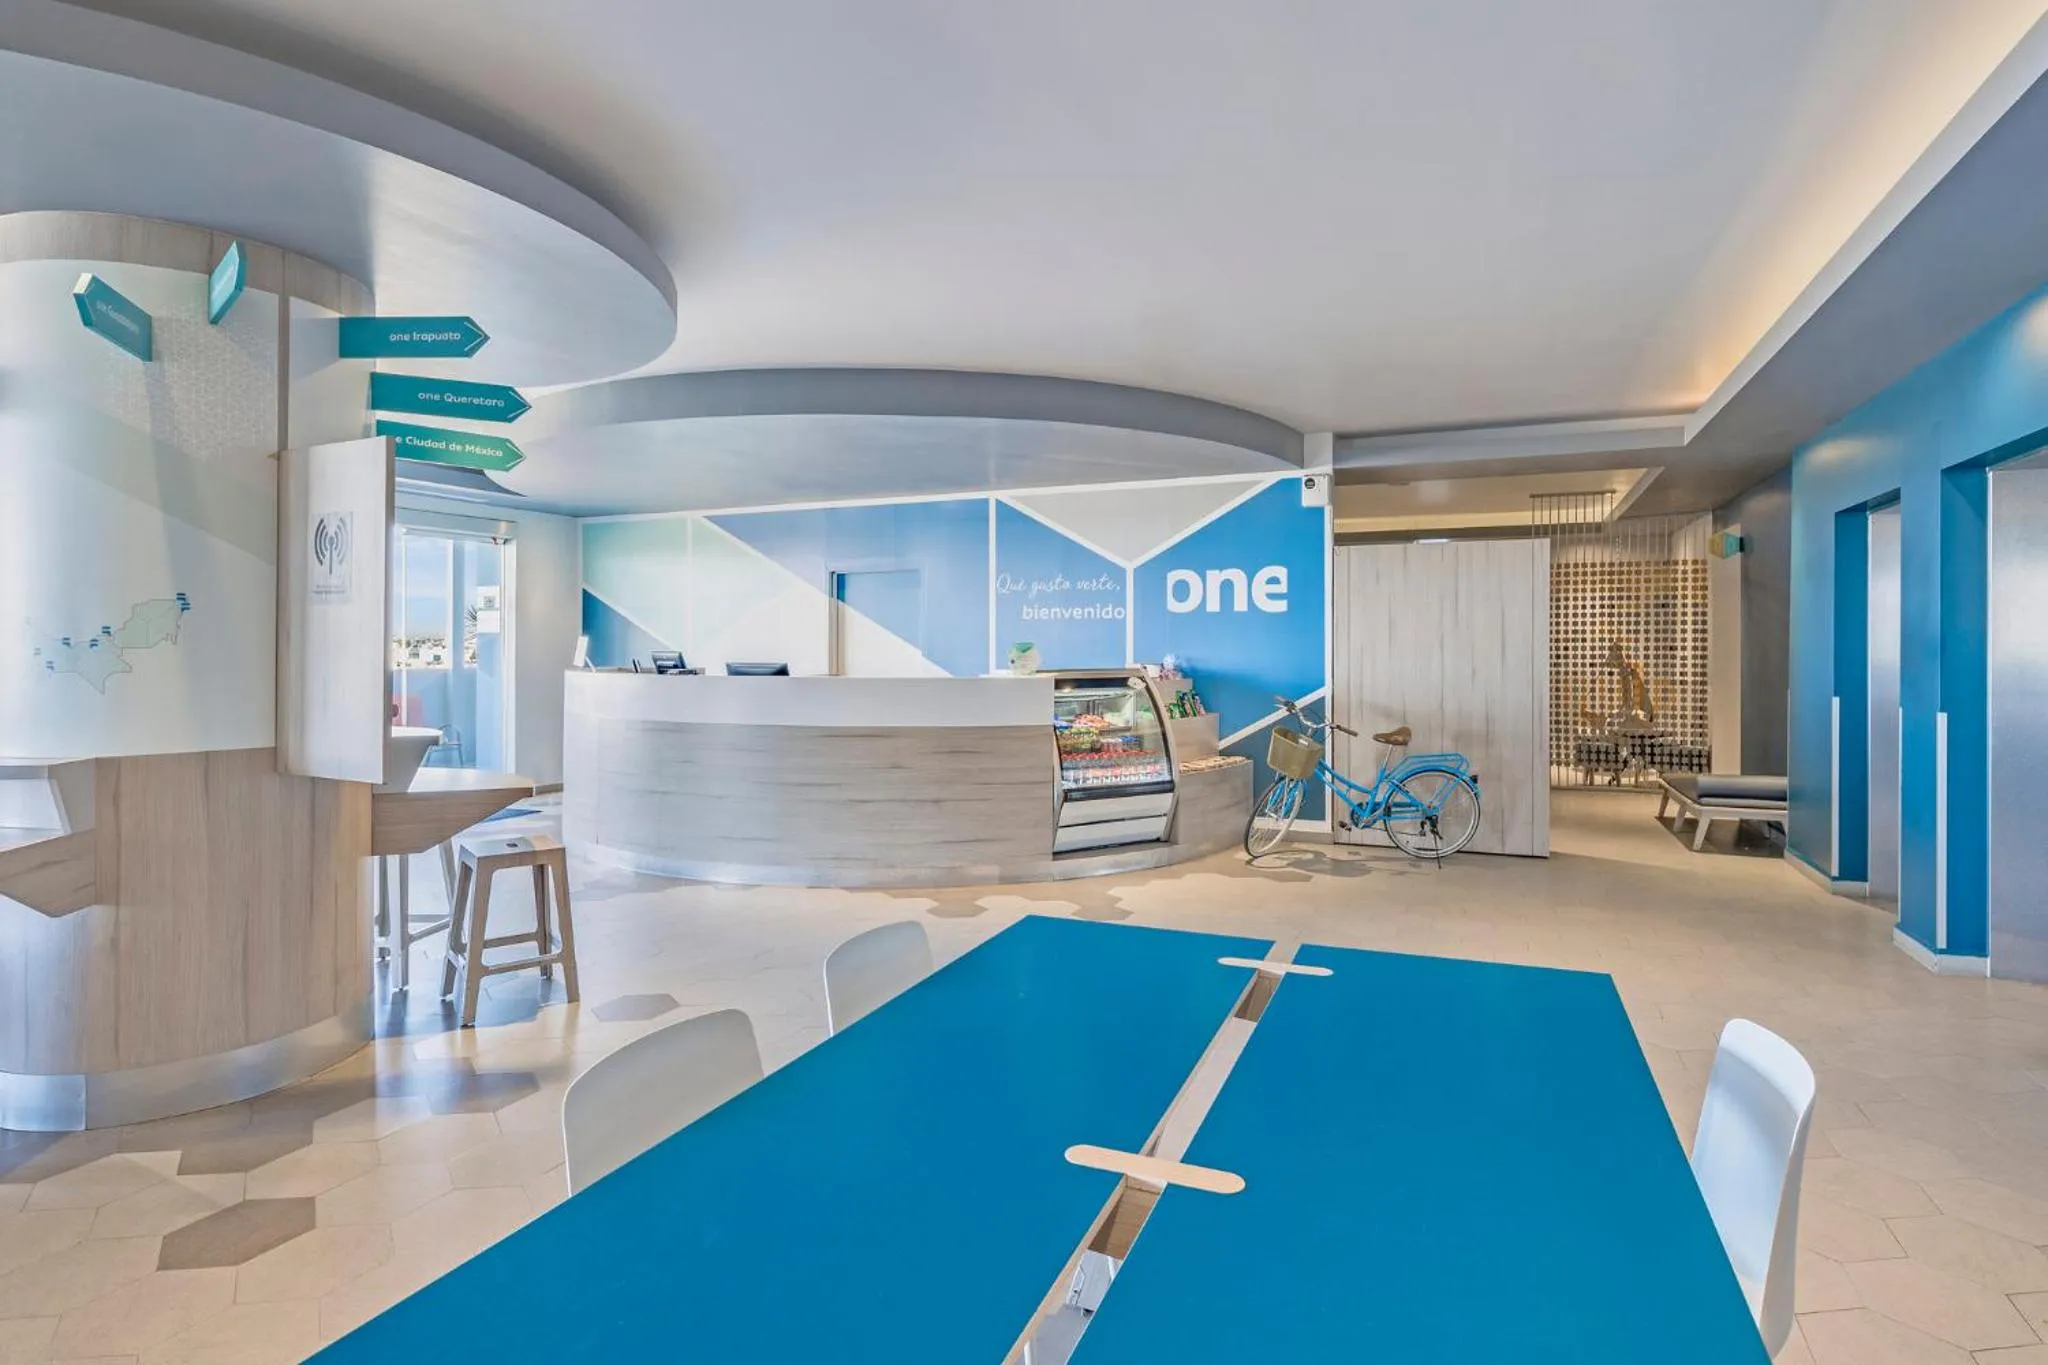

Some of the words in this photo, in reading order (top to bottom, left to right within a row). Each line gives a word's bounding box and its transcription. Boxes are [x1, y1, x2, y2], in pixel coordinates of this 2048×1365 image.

[390, 333, 411, 341] one
[412, 331, 461, 343] Irapuato
[417, 392, 441, 401] one
[405, 436, 446, 449] Ciudad
[448, 443, 462, 452] de
[465, 443, 504, 457] México
[1028, 574, 1071, 599] gusto
[1166, 565, 1289, 613] one
[1021, 603, 1126, 620] bienvenido
